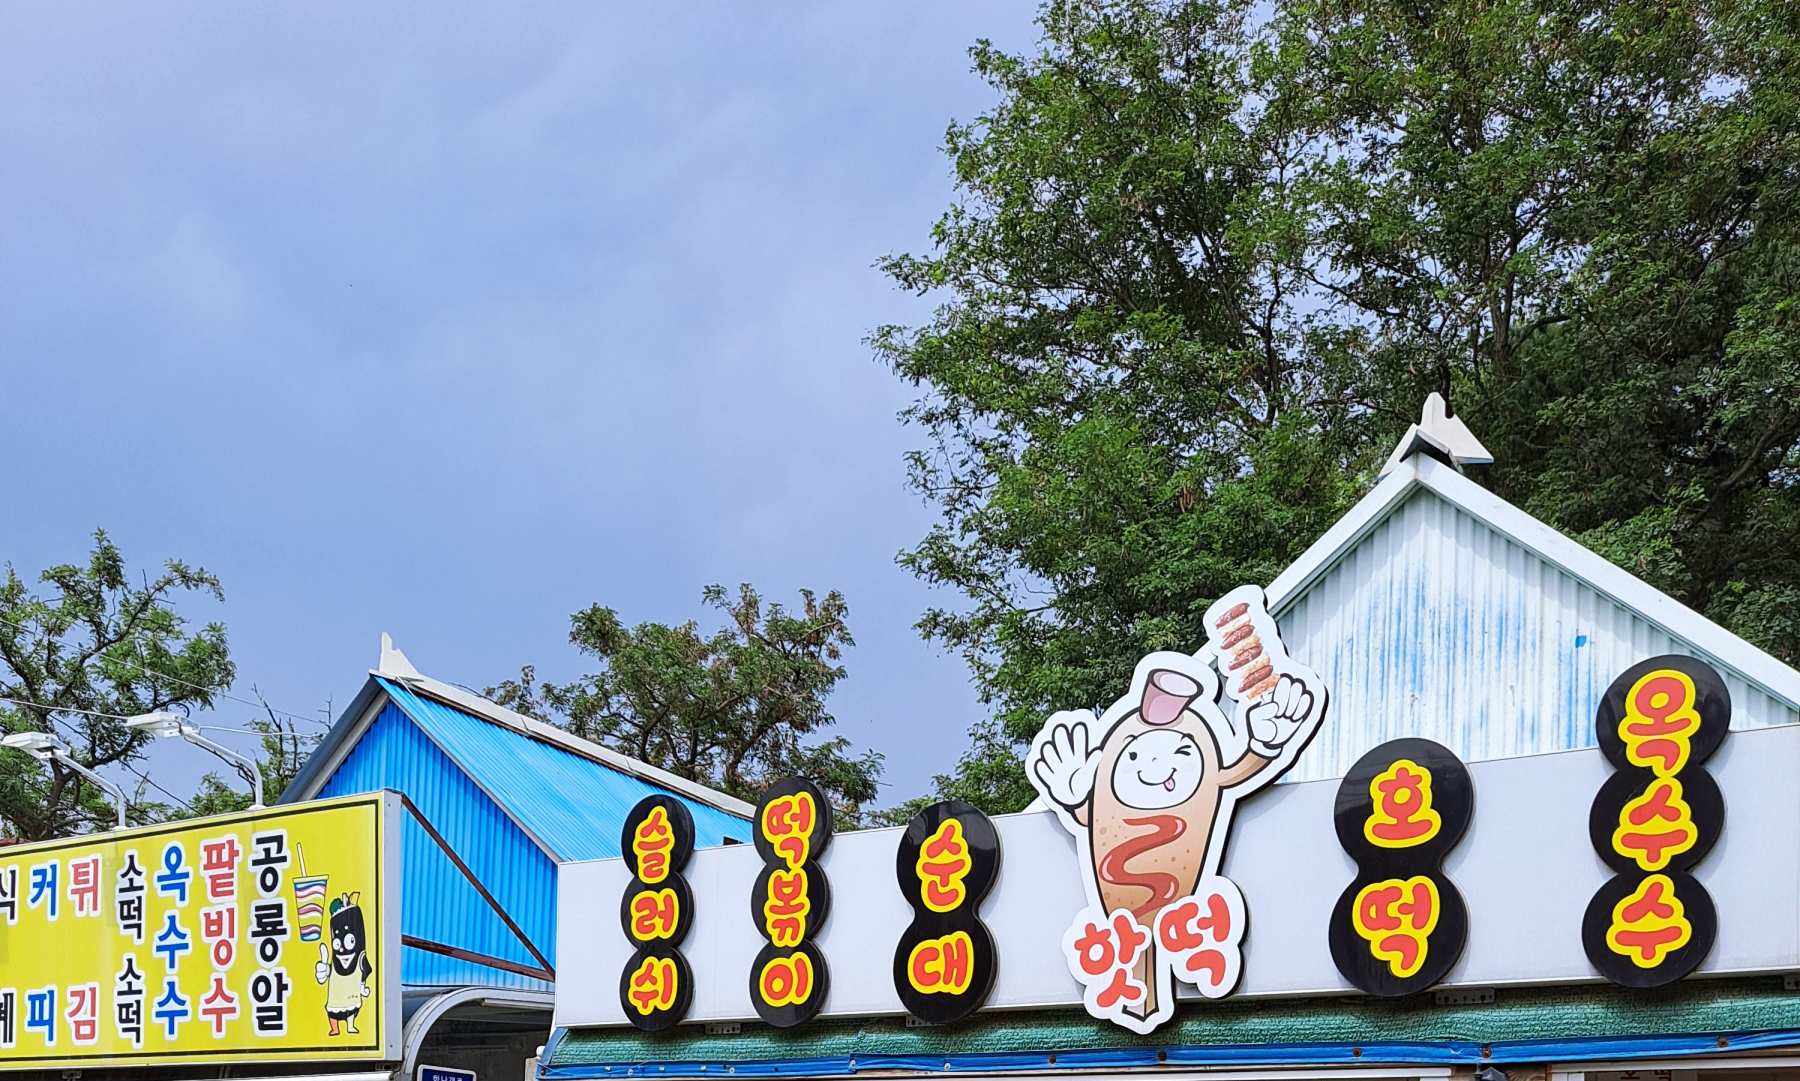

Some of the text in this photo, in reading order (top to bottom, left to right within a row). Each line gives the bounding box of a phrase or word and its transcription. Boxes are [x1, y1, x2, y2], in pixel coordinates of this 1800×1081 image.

[630, 808, 677, 1014] 슬러쉬
[761, 793, 815, 1006] 떡볶이
[909, 819, 973, 993] 순대
[1353, 761, 1440, 975] 호떡
[1608, 672, 1699, 967] 옥수수
[27, 863, 58, 1043] 커피
[67, 858, 100, 1042] 튀김
[116, 854, 144, 1043] 소떡소떡
[155, 844, 191, 1036] 옥수수
[201, 840, 239, 1034] 팥빙수
[251, 835, 288, 1031] 공룡알
[1074, 892, 1232, 1008] 핫떡
